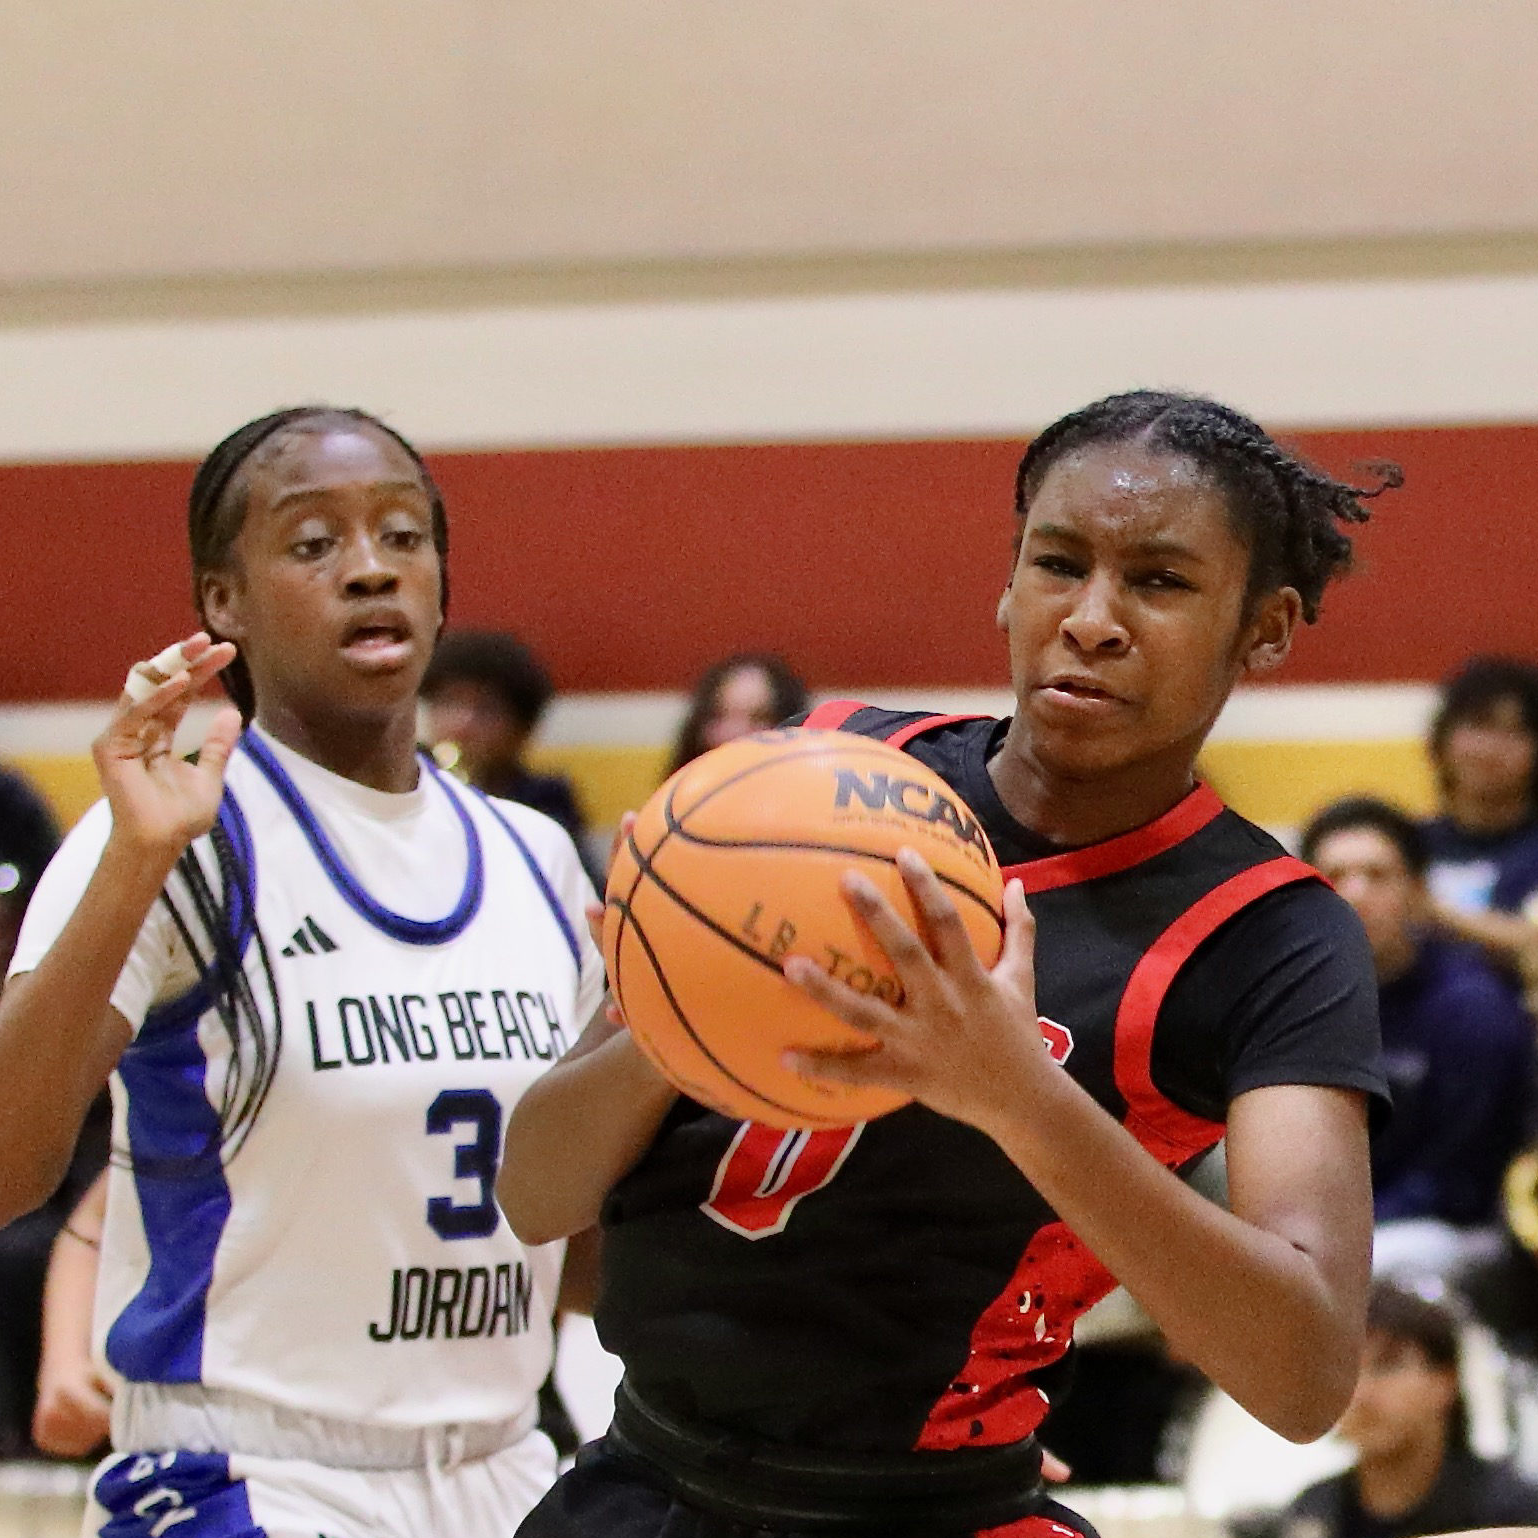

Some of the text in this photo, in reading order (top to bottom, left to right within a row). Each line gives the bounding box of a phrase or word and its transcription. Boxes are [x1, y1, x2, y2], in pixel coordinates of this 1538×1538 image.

[306, 990, 568, 1071] LONG BEACH
[425, 1088, 503, 1241] 3
[368, 1262, 532, 1342] JORDAN
